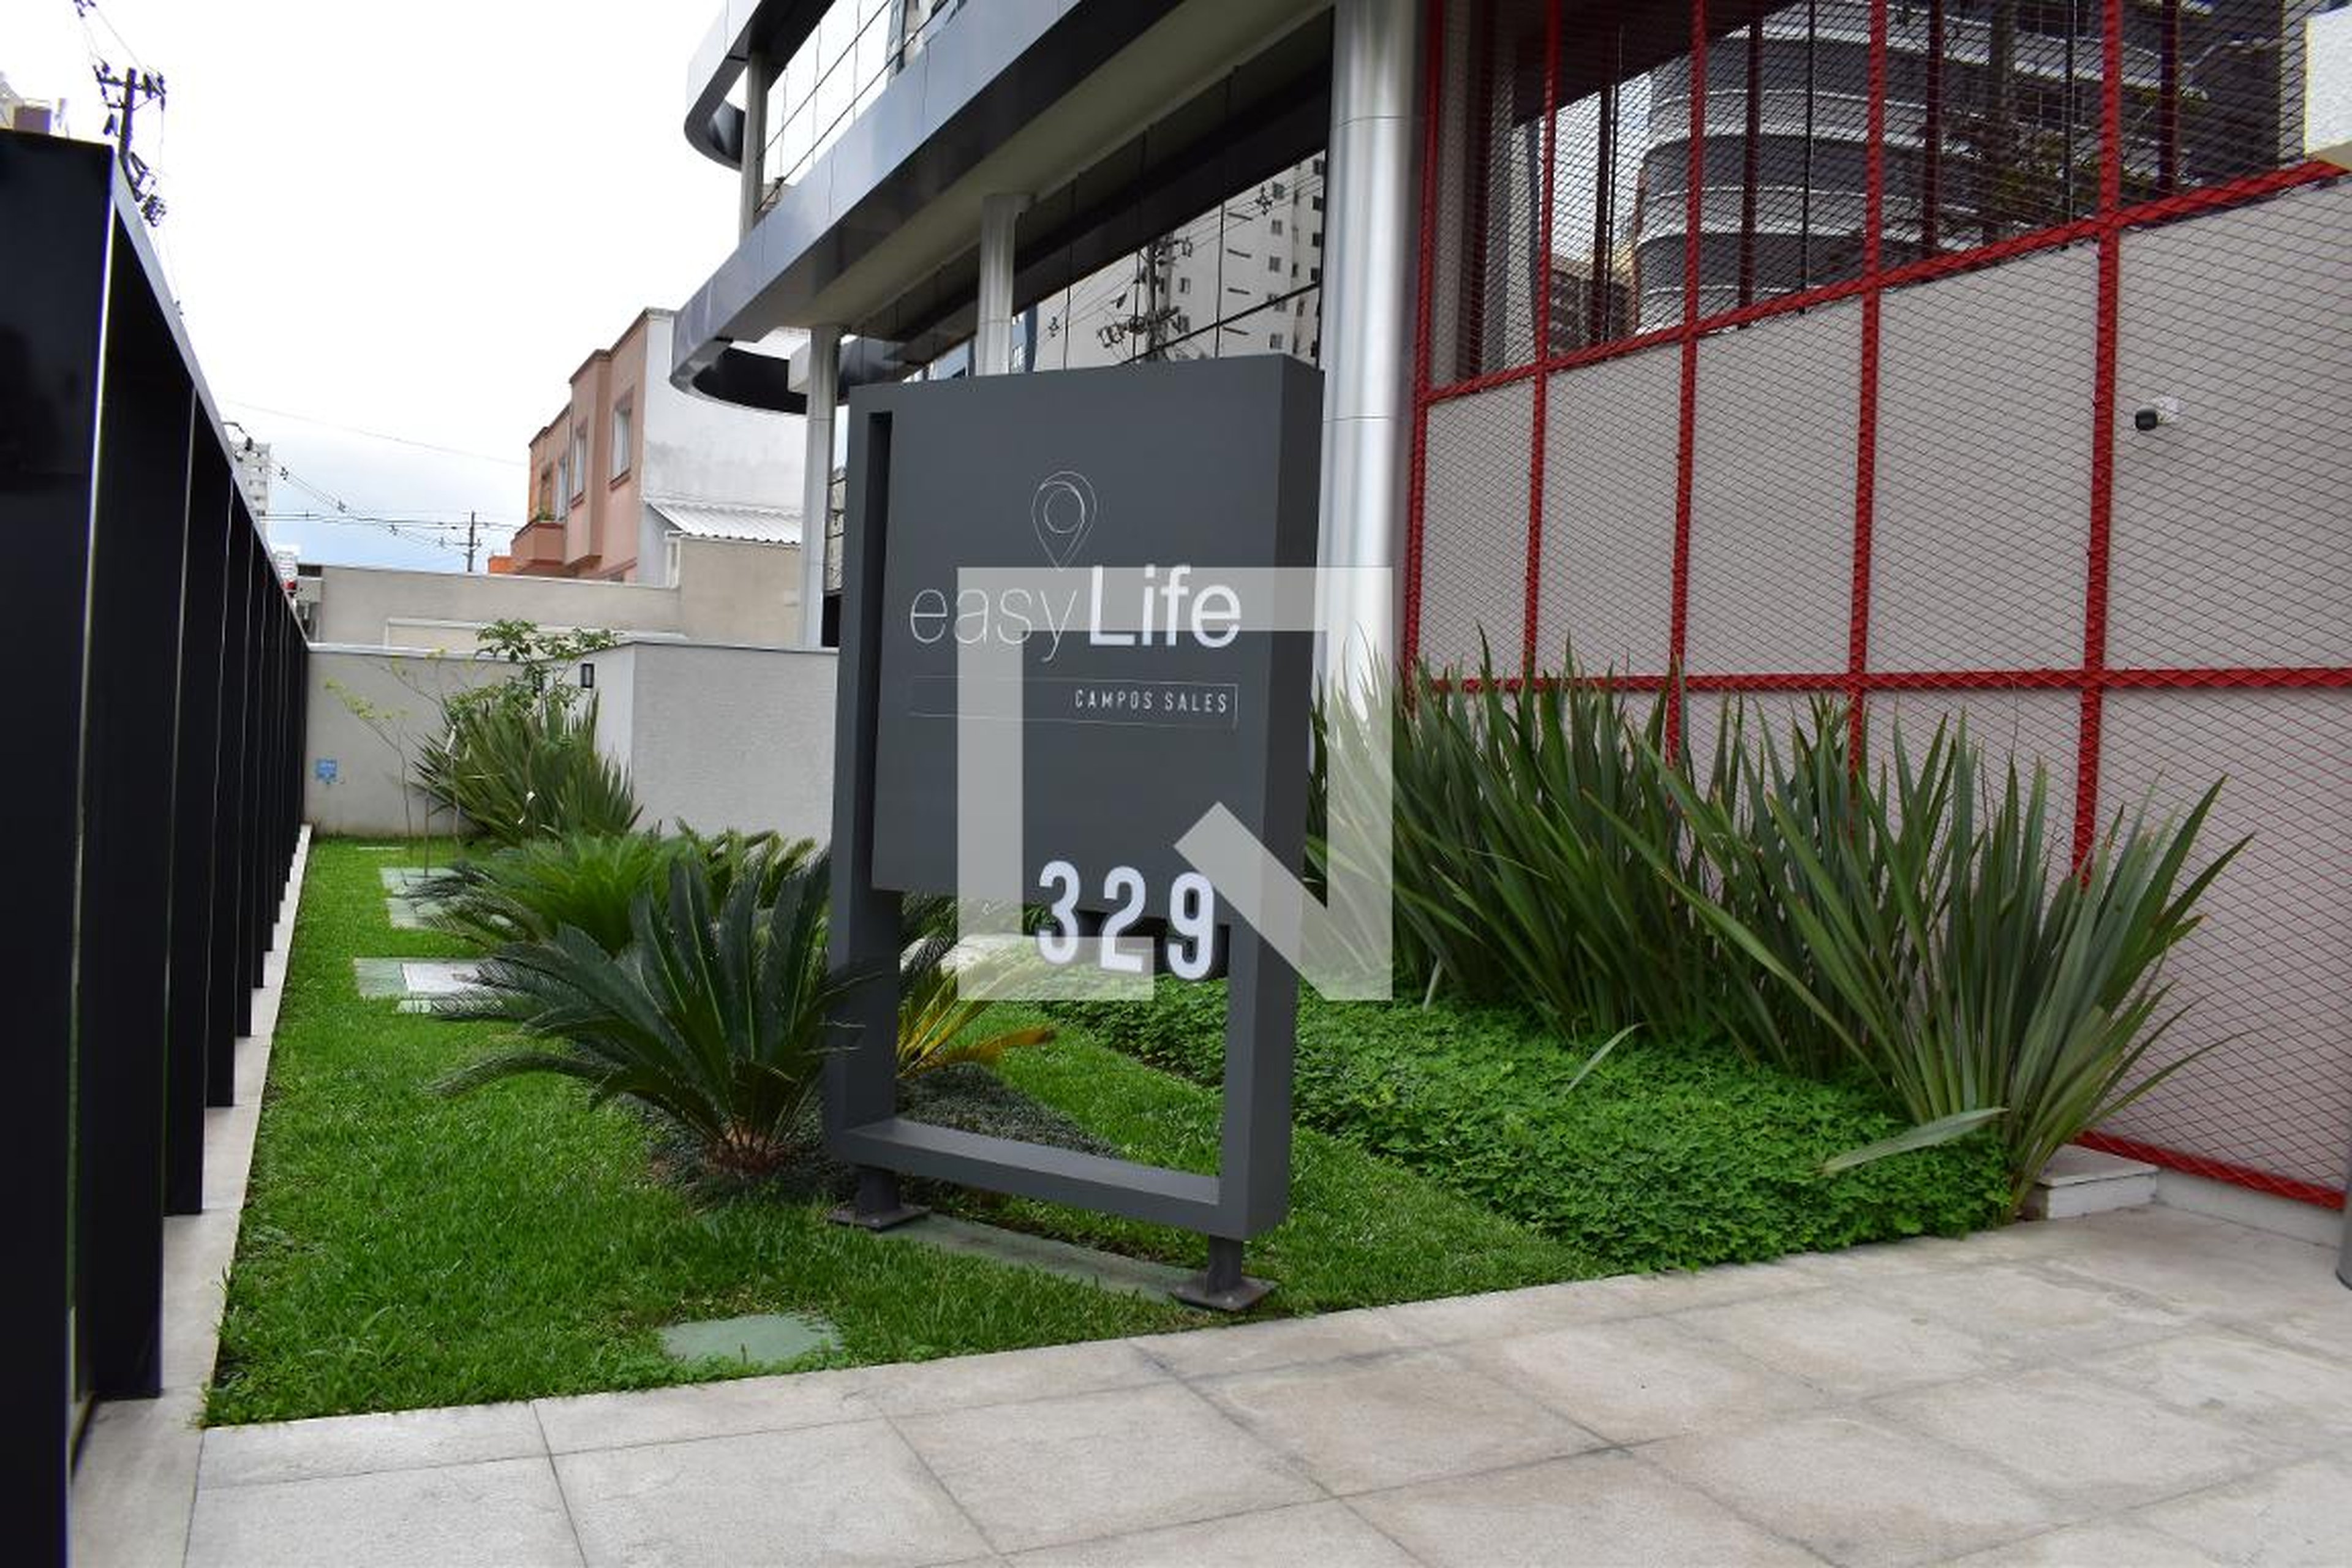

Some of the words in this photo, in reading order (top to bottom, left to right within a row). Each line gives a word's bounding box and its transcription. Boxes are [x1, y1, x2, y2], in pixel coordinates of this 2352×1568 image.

[1075, 689, 1153, 710] CAMPOS
[1164, 691, 1227, 712] SALES
[1039, 860, 1215, 980] 329
